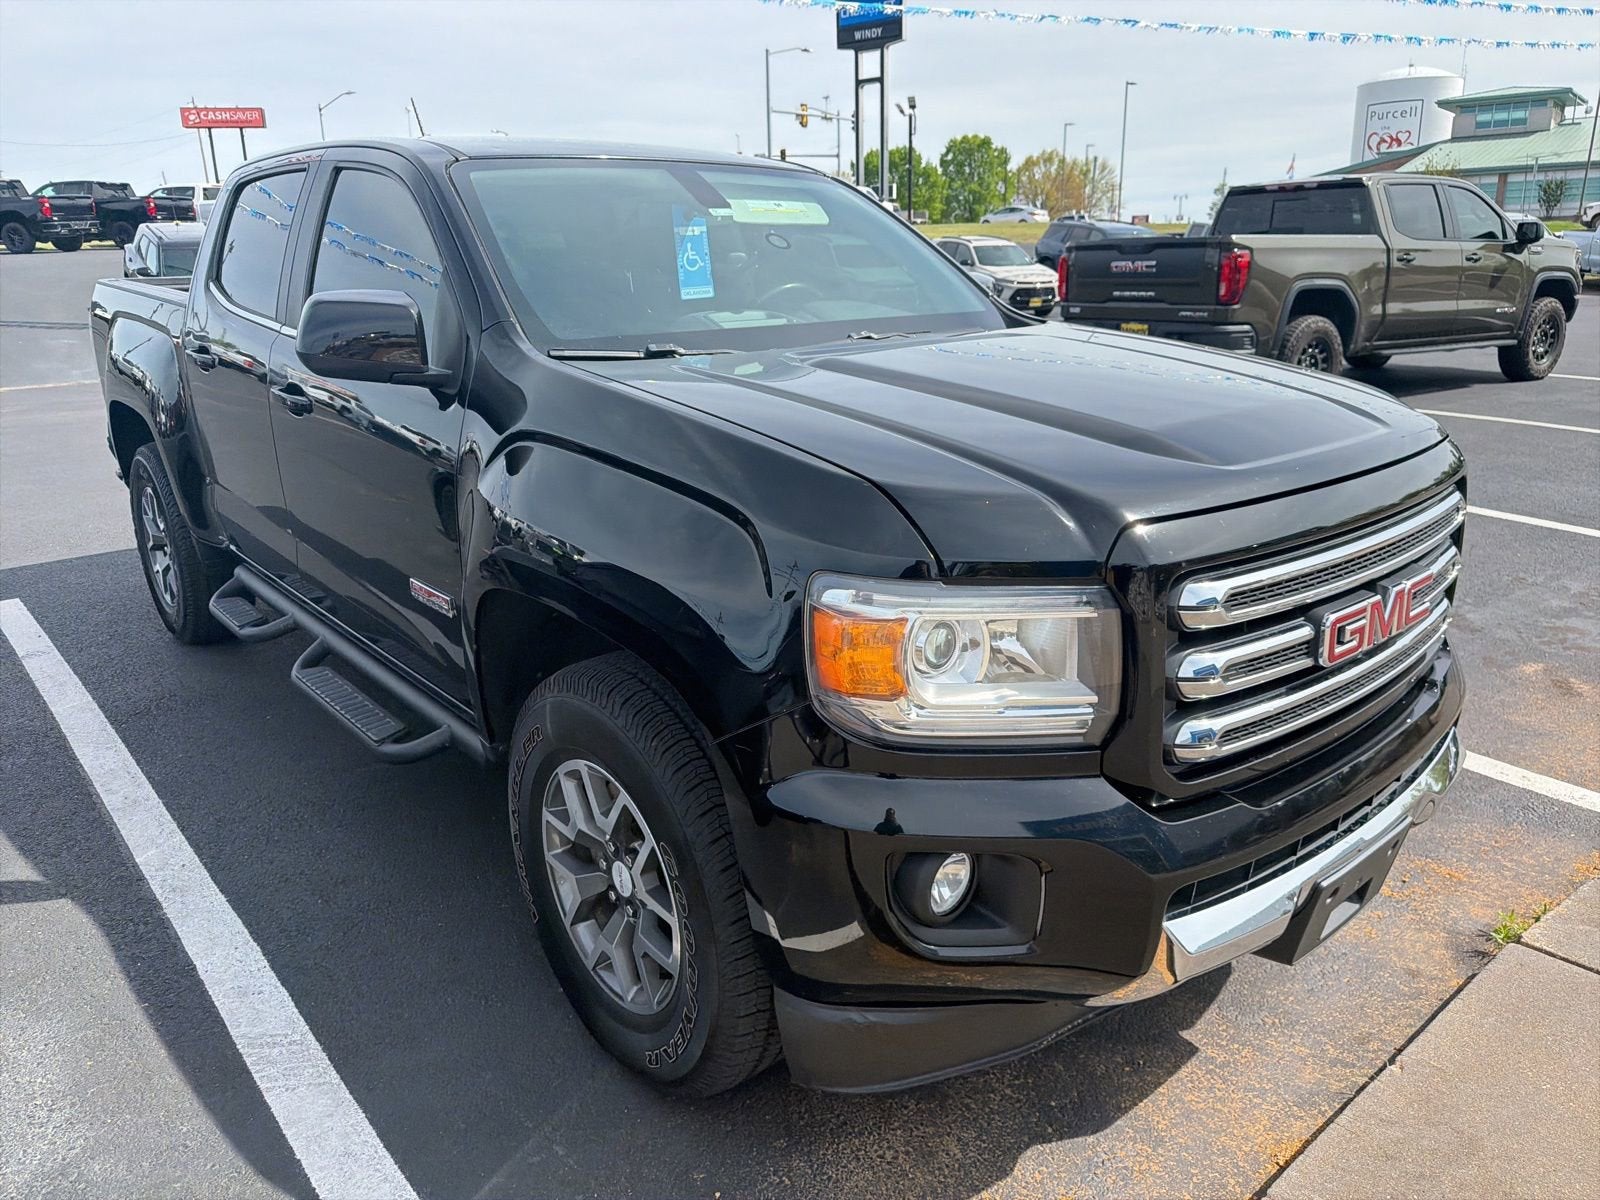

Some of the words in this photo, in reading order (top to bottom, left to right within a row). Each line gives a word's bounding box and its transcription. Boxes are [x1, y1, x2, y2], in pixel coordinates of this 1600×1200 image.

[854, 27, 883, 40] WINDY
[1369, 105, 1418, 121] Purcell
[1110, 260, 1157, 272] GMC
[1320, 568, 1435, 668] GMC
[645, 841, 699, 1068] GOODYEAR
